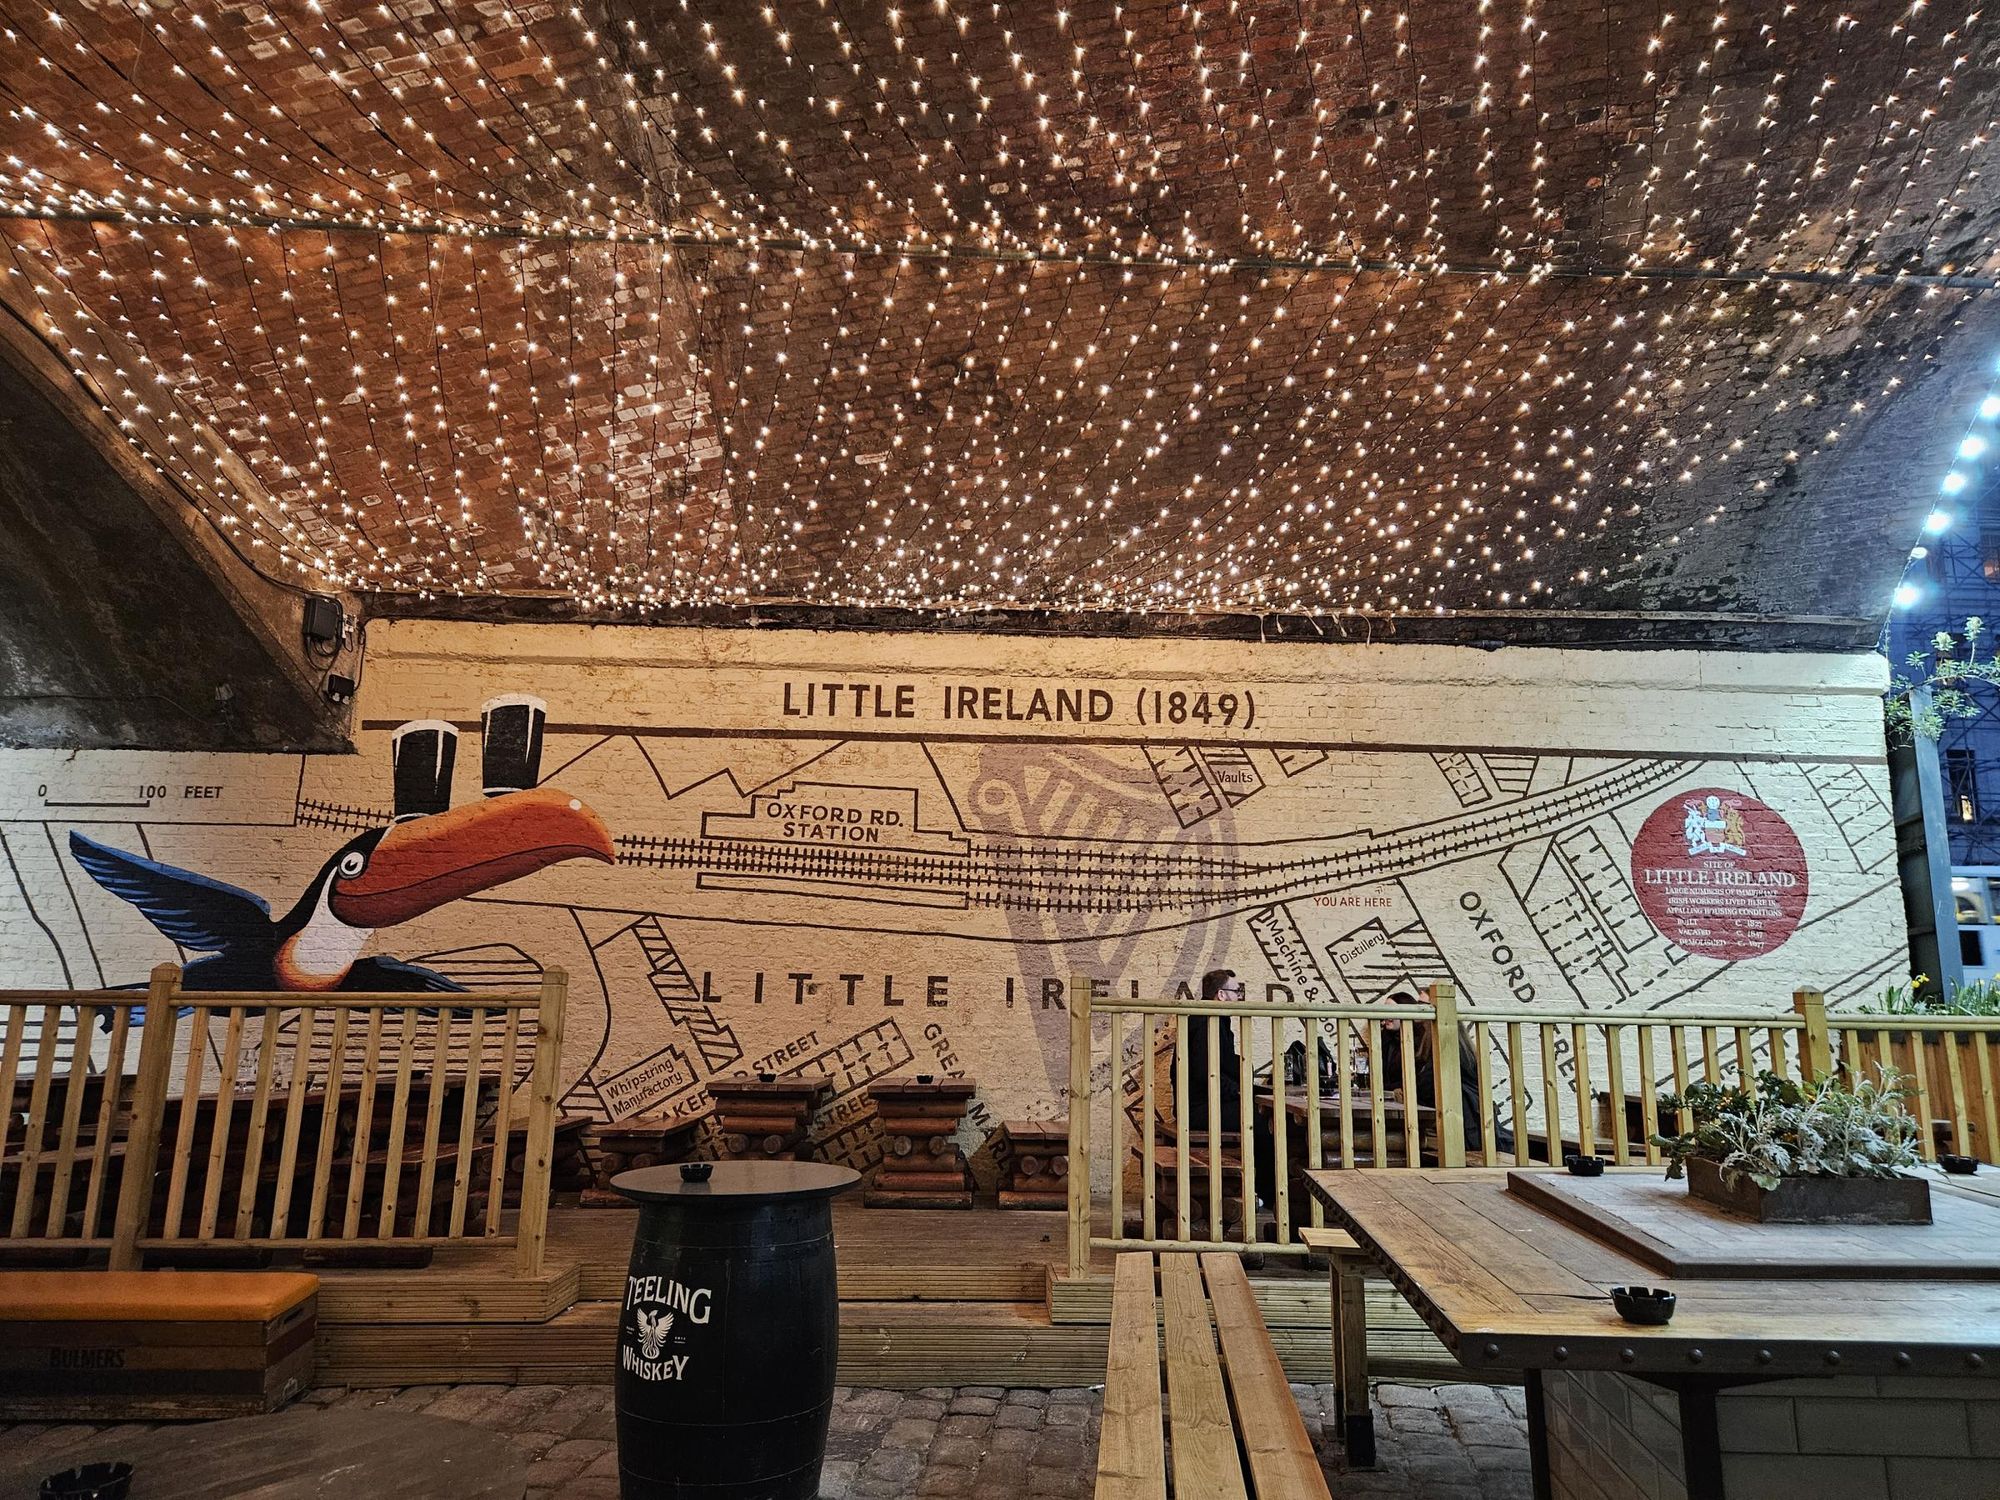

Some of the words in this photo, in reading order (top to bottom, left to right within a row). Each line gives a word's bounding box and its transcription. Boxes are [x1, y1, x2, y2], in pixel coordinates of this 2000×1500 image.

[782, 682, 915, 720] LITTLE
[943, 686, 1113, 723] IRELAND
[1136, 687, 1256, 730] (1849)
[38, 784, 48, 798] 0
[138, 785, 167, 799] 100
[184, 785, 224, 799] FEET
[1217, 770, 1253, 783] Vaults
[766, 802, 862, 825] OXFORD
[864, 805, 904, 827] RD.
[783, 823, 879, 844] STATION
[1644, 869, 1710, 885] LITTLE
[1715, 871, 1797, 888] IRELAND
[1703, 860, 1723, 869] SITE
[1724, 861, 1736, 869] OF
[1313, 897, 1338, 907] YOU
[1339, 897, 1361, 908] ARE
[1364, 897, 1393, 908] HERE
[1265, 918, 1308, 986] Machine
[1304, 986, 1319, 1002] &
[1339, 932, 1386, 965] Distillery
[1459, 891, 1536, 1003] OXFORD
[702, 971, 948, 1008] LITTLE
[752, 1030, 820, 1075] STREET
[606, 1058, 675, 1100] Whipstring
[612, 1071, 683, 1116] Manufactory
[626, 1275, 712, 1324] TEELING
[49, 1346, 126, 1369] BULMERS
[622, 1344, 690, 1381] WHISKEY
